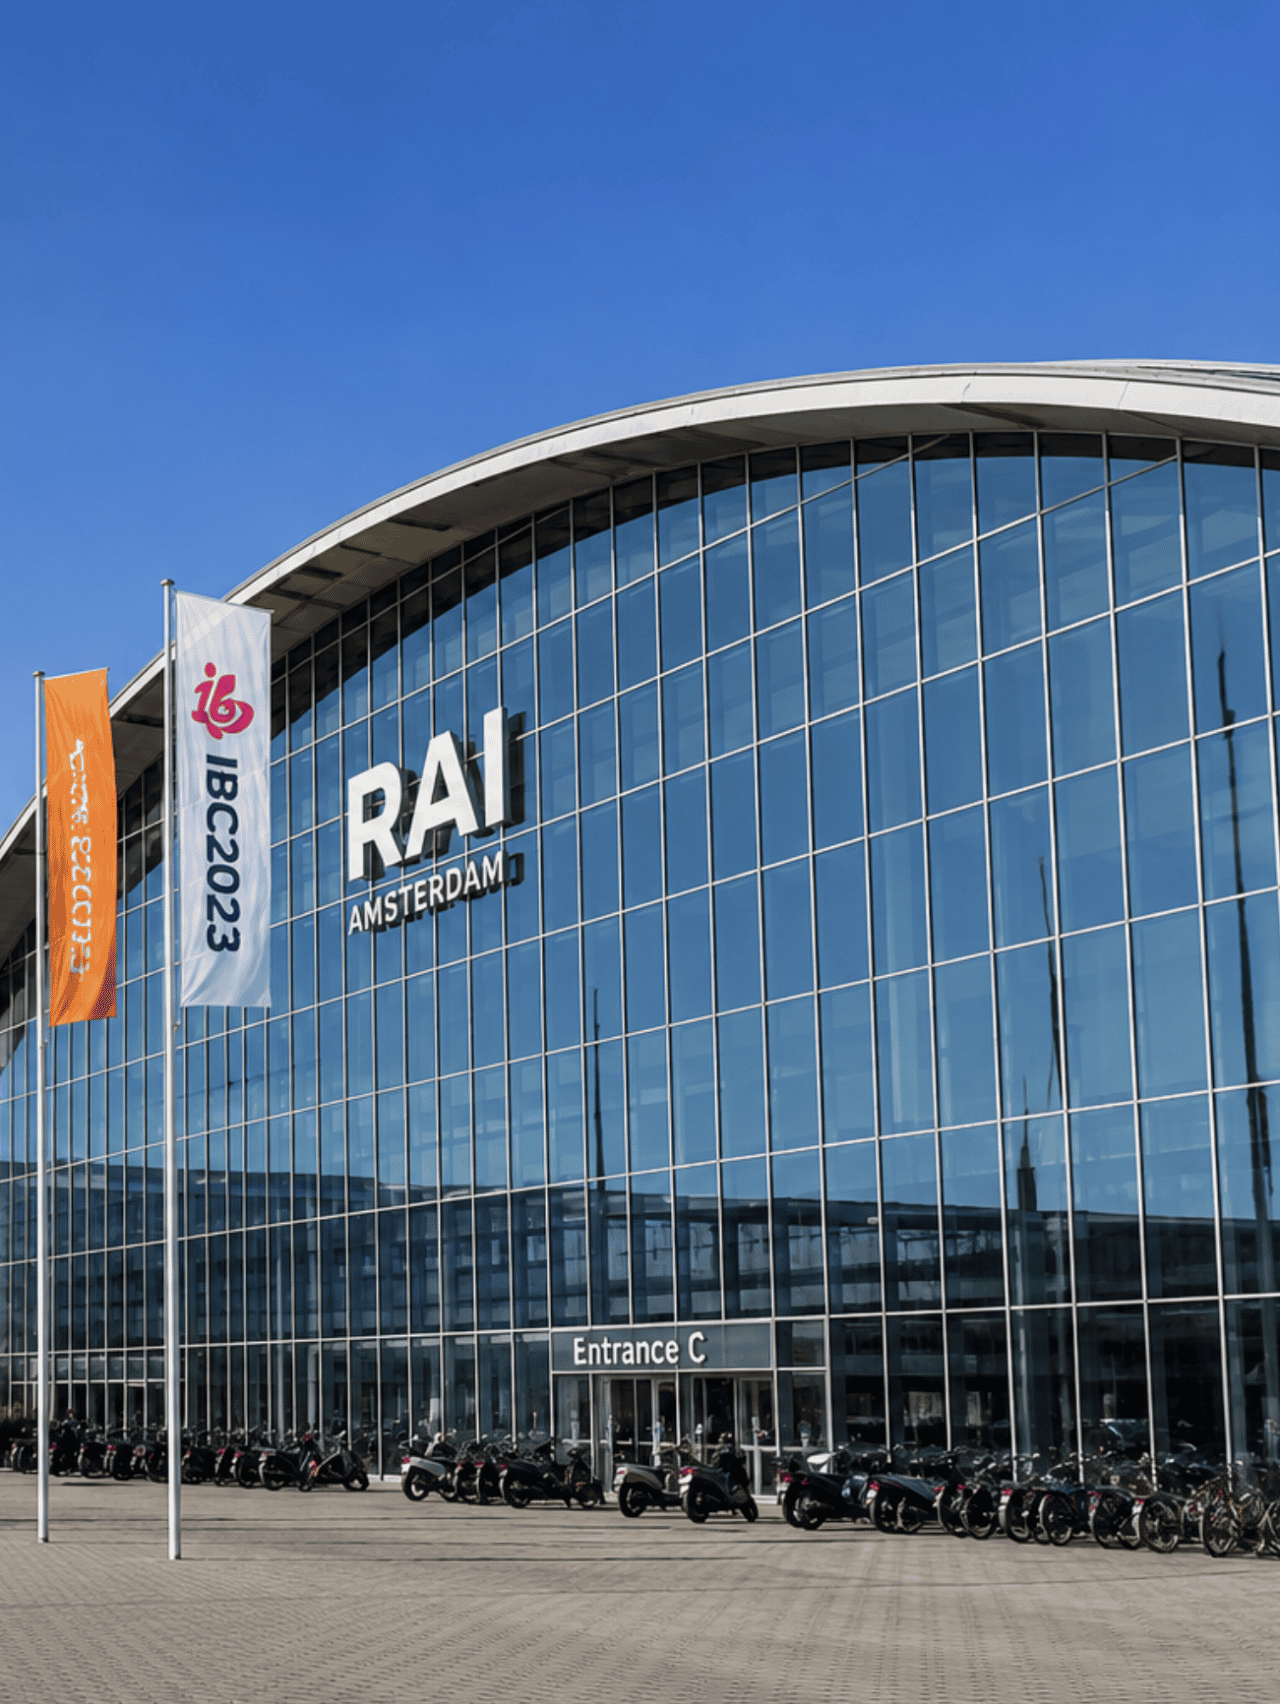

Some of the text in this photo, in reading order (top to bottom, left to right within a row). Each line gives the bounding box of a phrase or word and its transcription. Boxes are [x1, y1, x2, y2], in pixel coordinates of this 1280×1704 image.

[206, 753, 241, 953] IBC2023
[348, 706, 505, 883] RAI
[347, 850, 504, 936] AMSTERDAM
[573, 1330, 706, 1366] Entrance C
